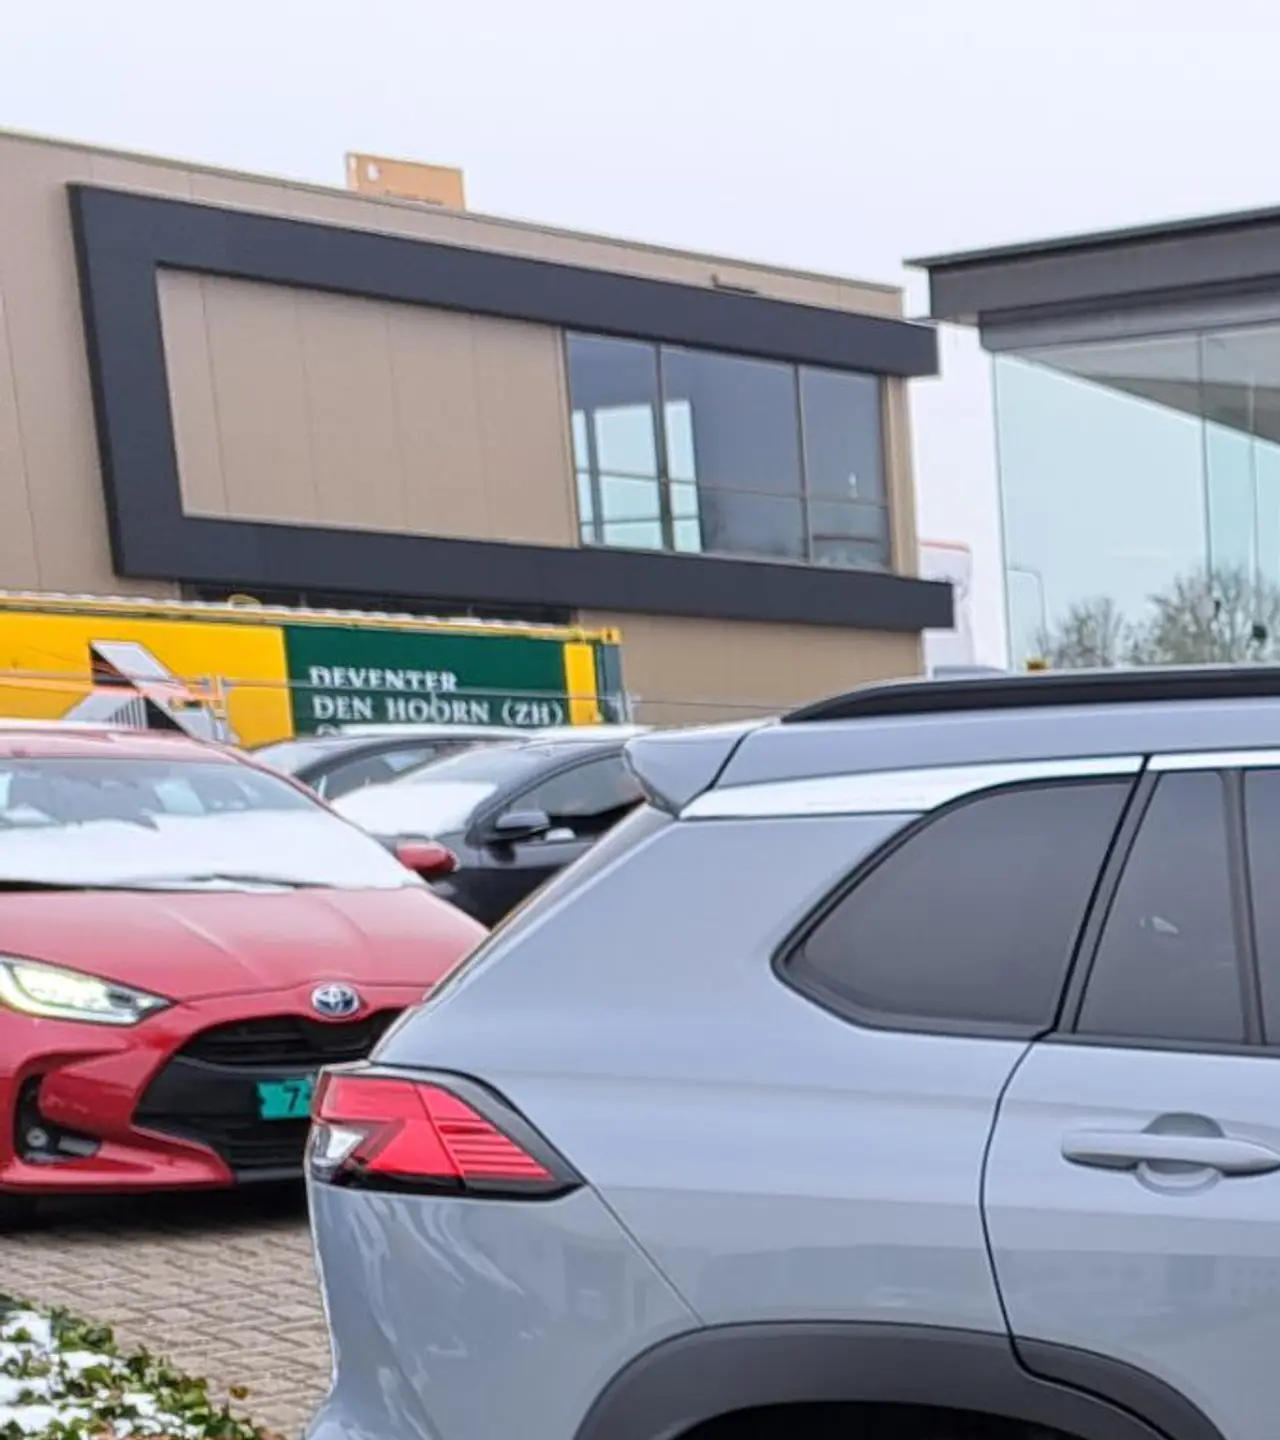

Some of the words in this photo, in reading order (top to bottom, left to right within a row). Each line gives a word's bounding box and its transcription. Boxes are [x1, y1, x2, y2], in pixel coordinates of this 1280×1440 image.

[308, 665, 458, 693] DEVENTER
[312, 694, 374, 720] DEN
[386, 696, 490, 723] HOORN
[501, 699, 564, 725] (ZH)
